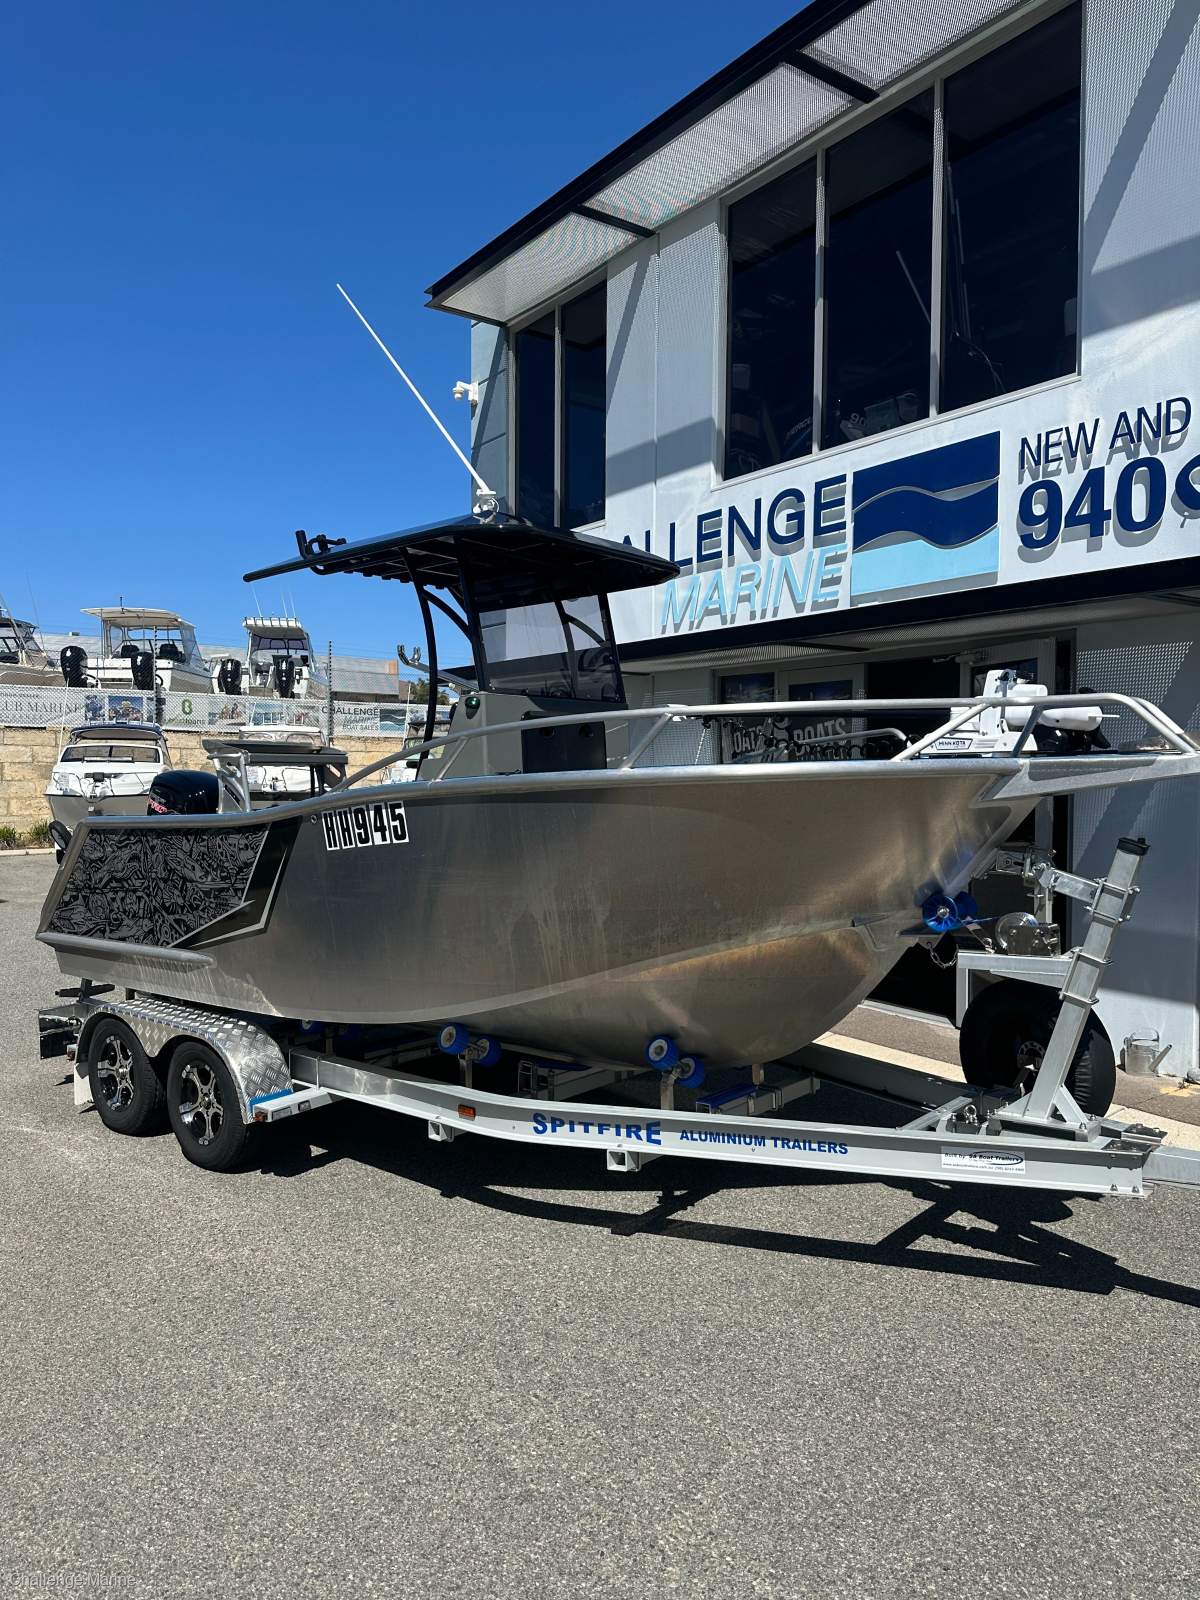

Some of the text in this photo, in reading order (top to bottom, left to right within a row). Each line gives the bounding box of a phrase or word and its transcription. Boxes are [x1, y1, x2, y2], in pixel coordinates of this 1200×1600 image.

[1020, 396, 1192, 470] NEW AND
[660, 543, 848, 626] MARINE
[321, 706, 380, 716] CHALLENGE
[322, 801, 408, 850] HH945
[532, 1112, 662, 1146] SPITFIRE
[679, 1129, 848, 1155] ALUMINIUM TRAILERS
